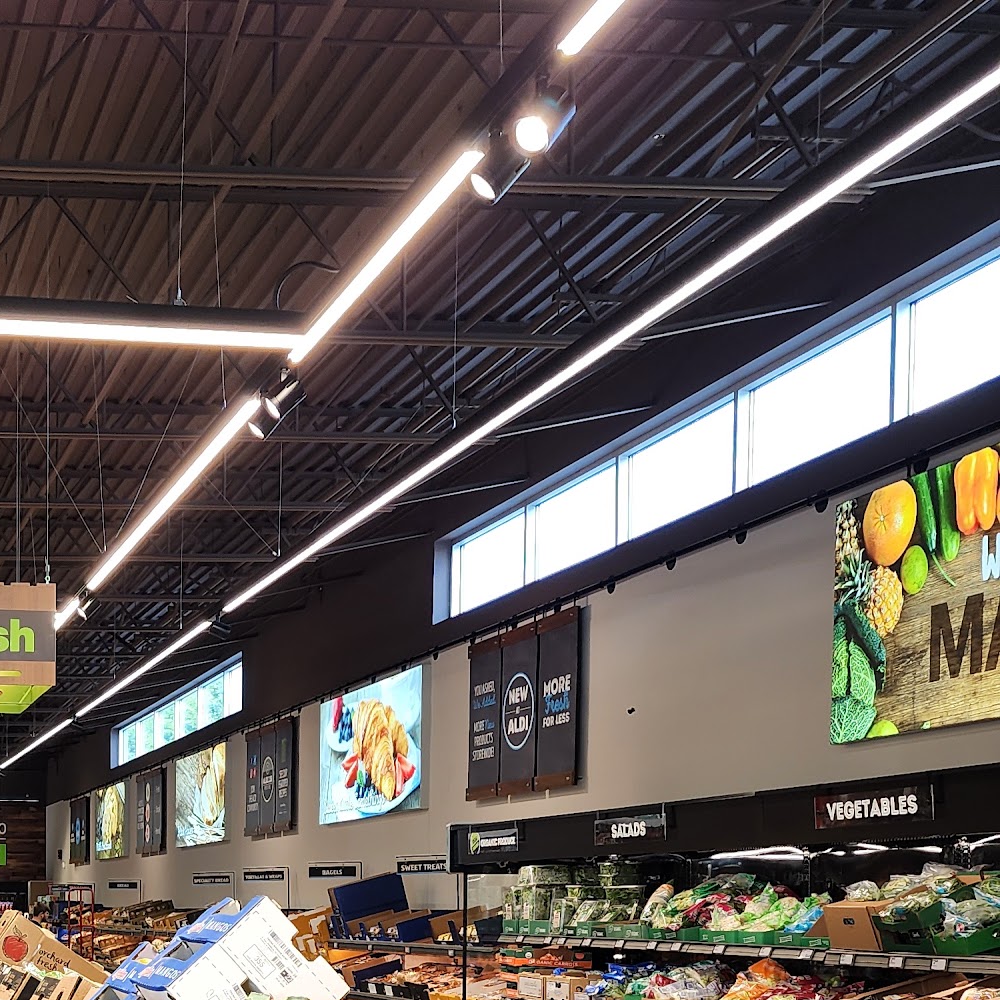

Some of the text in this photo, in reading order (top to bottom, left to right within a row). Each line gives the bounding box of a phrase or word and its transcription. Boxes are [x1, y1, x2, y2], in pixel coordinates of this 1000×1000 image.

[508, 685, 529, 705] NEW
[543, 674, 571, 698] MORE
[544, 691, 571, 715] Fresh
[473, 720, 485, 733] MORE
[507, 715, 529, 735] ALDI
[542, 712, 570, 728] FOR LESS
[473, 732, 494, 747] PRODUCTS
[826, 794, 919, 821] VEGETABLES
[611, 821, 647, 839] SALADS
[321, 868, 343, 876] BAGELS
[401, 863, 423, 872] SWEET
[37, 956, 58, 971] fresh
[38, 949, 72, 968] orchard
